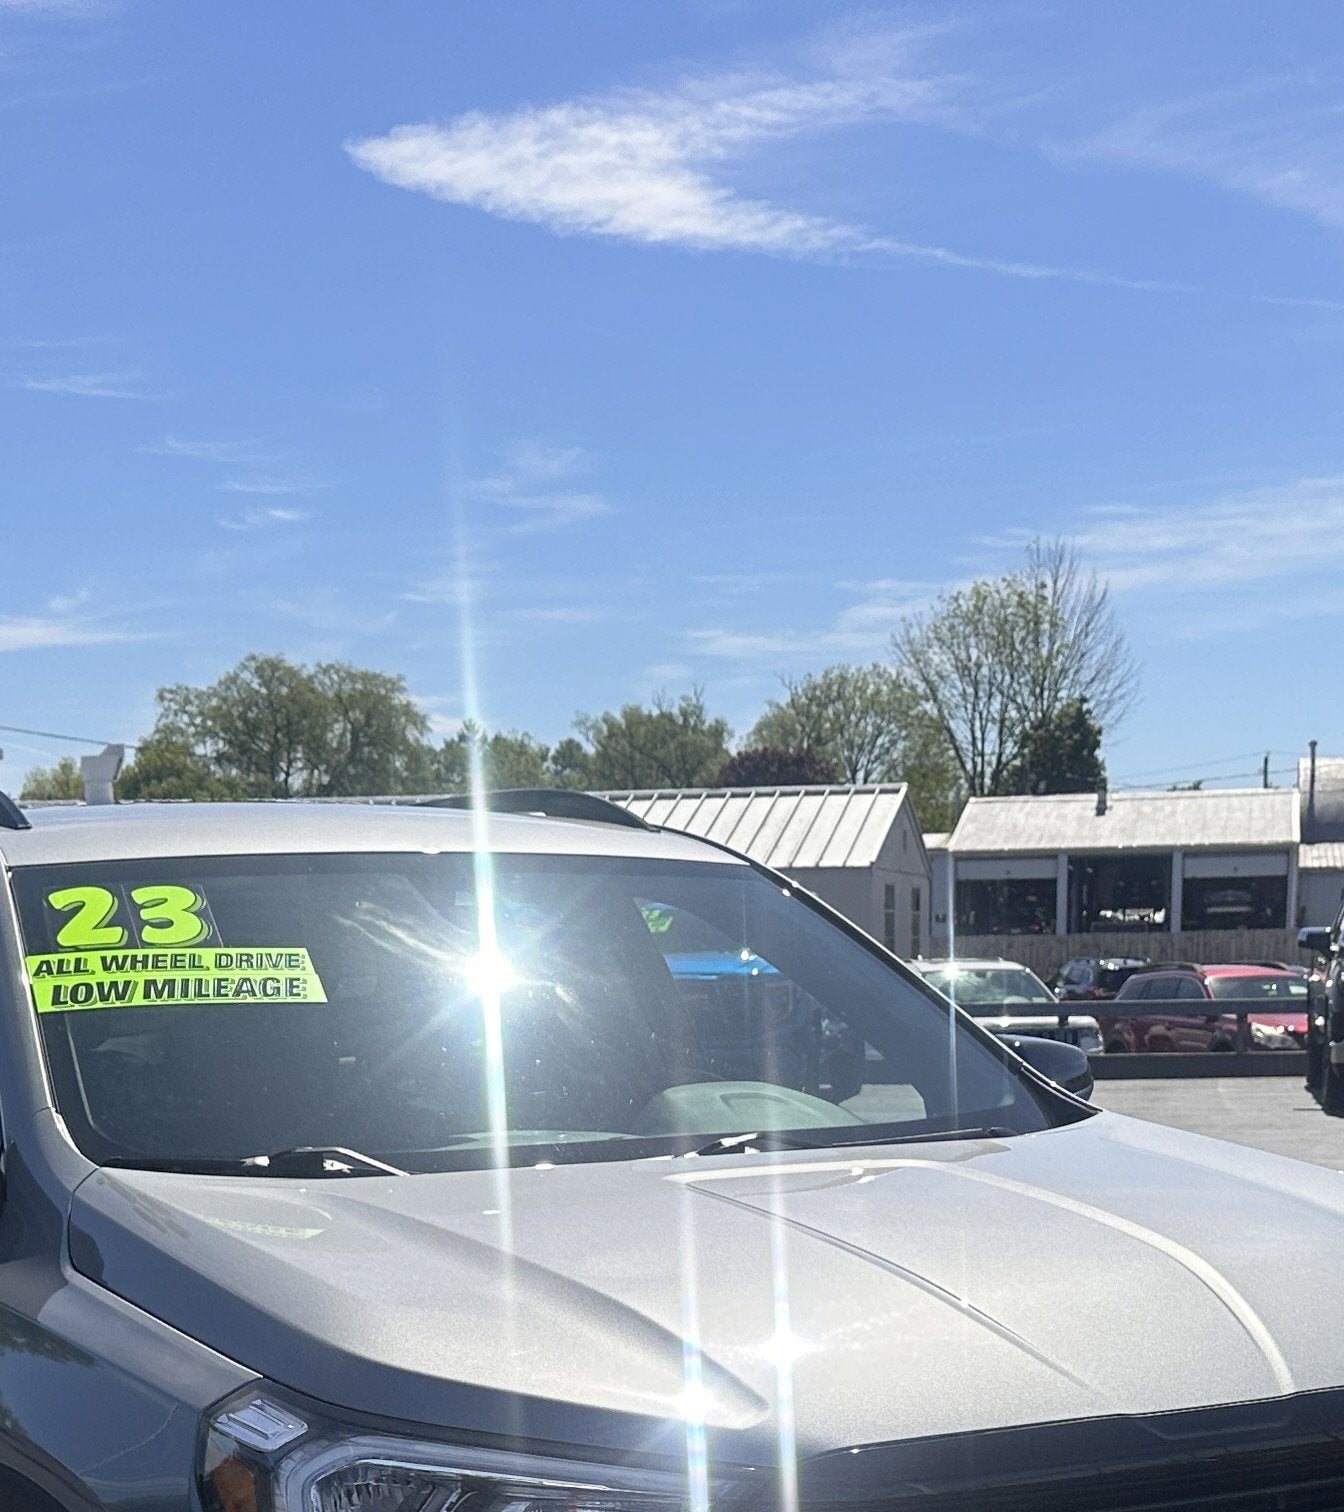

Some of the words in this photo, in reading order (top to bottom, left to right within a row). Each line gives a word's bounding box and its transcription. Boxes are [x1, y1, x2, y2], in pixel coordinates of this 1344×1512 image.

[47, 885, 209, 948] 23
[33, 957, 96, 977] ALL
[100, 953, 210, 974] WHEEL
[213, 952, 307, 972] DRIVE
[51, 978, 139, 1007] LOW
[141, 976, 308, 1003] MILEAGE
